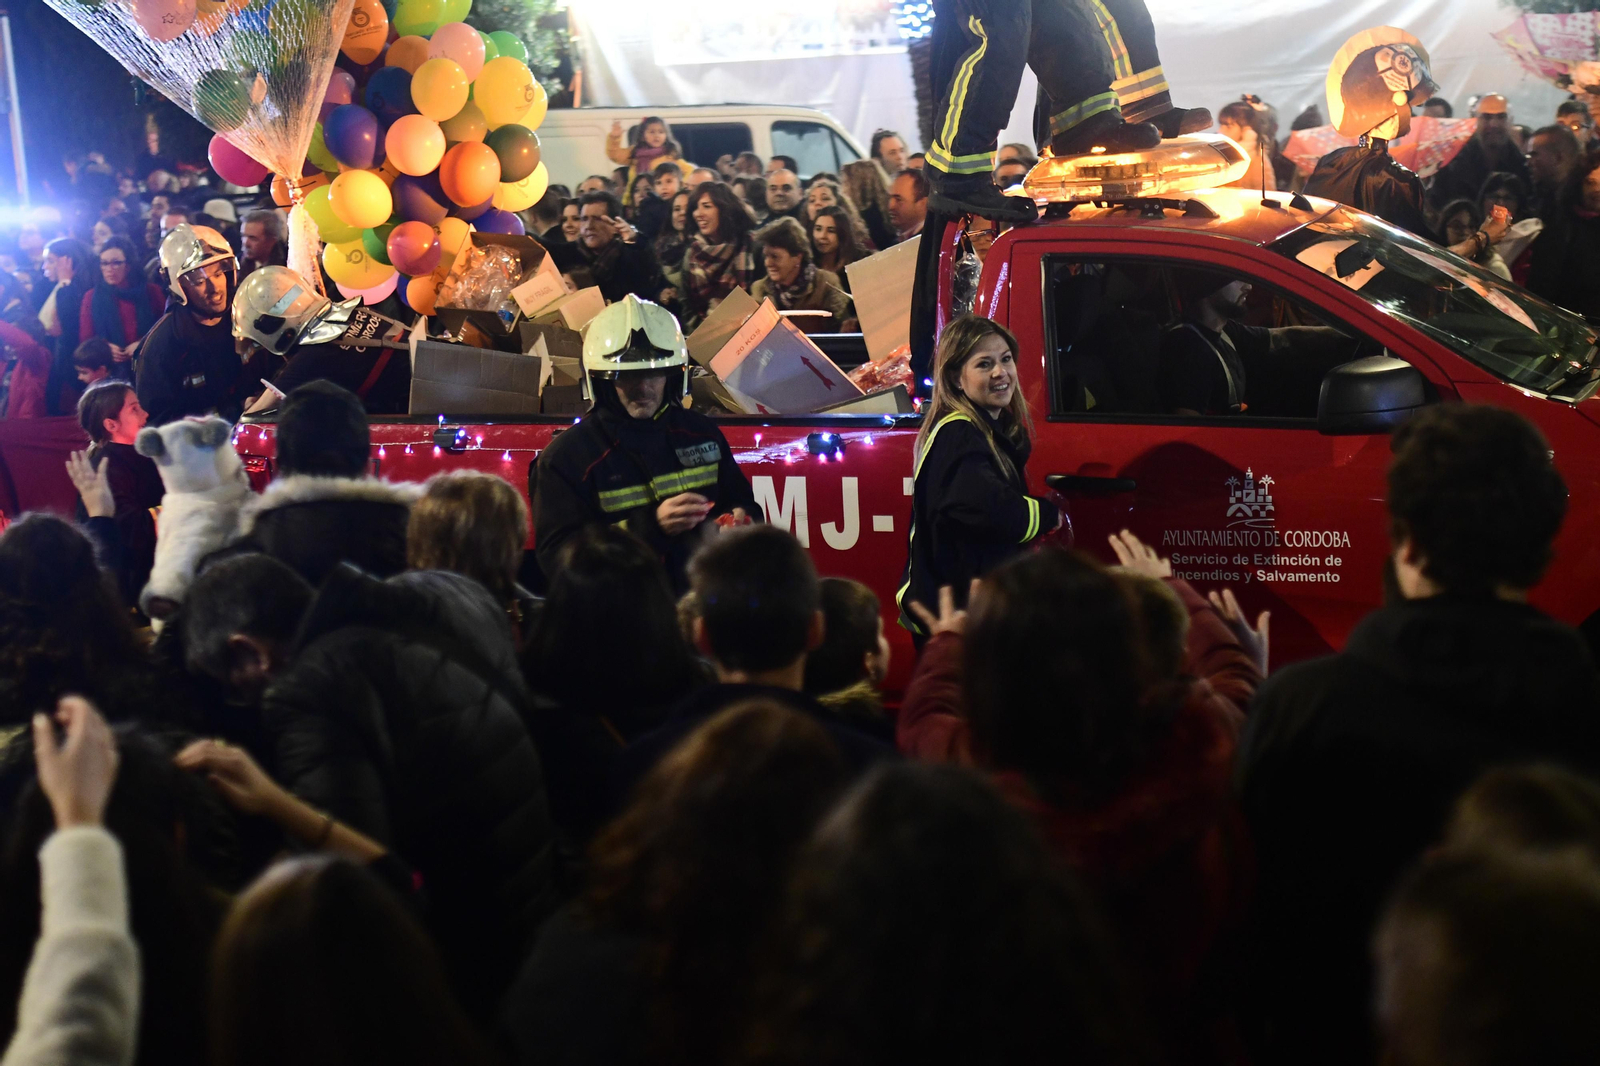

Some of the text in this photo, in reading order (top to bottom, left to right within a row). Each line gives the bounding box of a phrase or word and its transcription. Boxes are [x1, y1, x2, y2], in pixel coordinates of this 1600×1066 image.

[735, 346, 745, 356] 20
[1162, 530, 1351, 548] AYUNTAMIENTO DE CORDOBA
[1171, 552, 1342, 566] Servicio de Extinción de
[1172, 568, 1341, 583] Incendios y Salvamento
